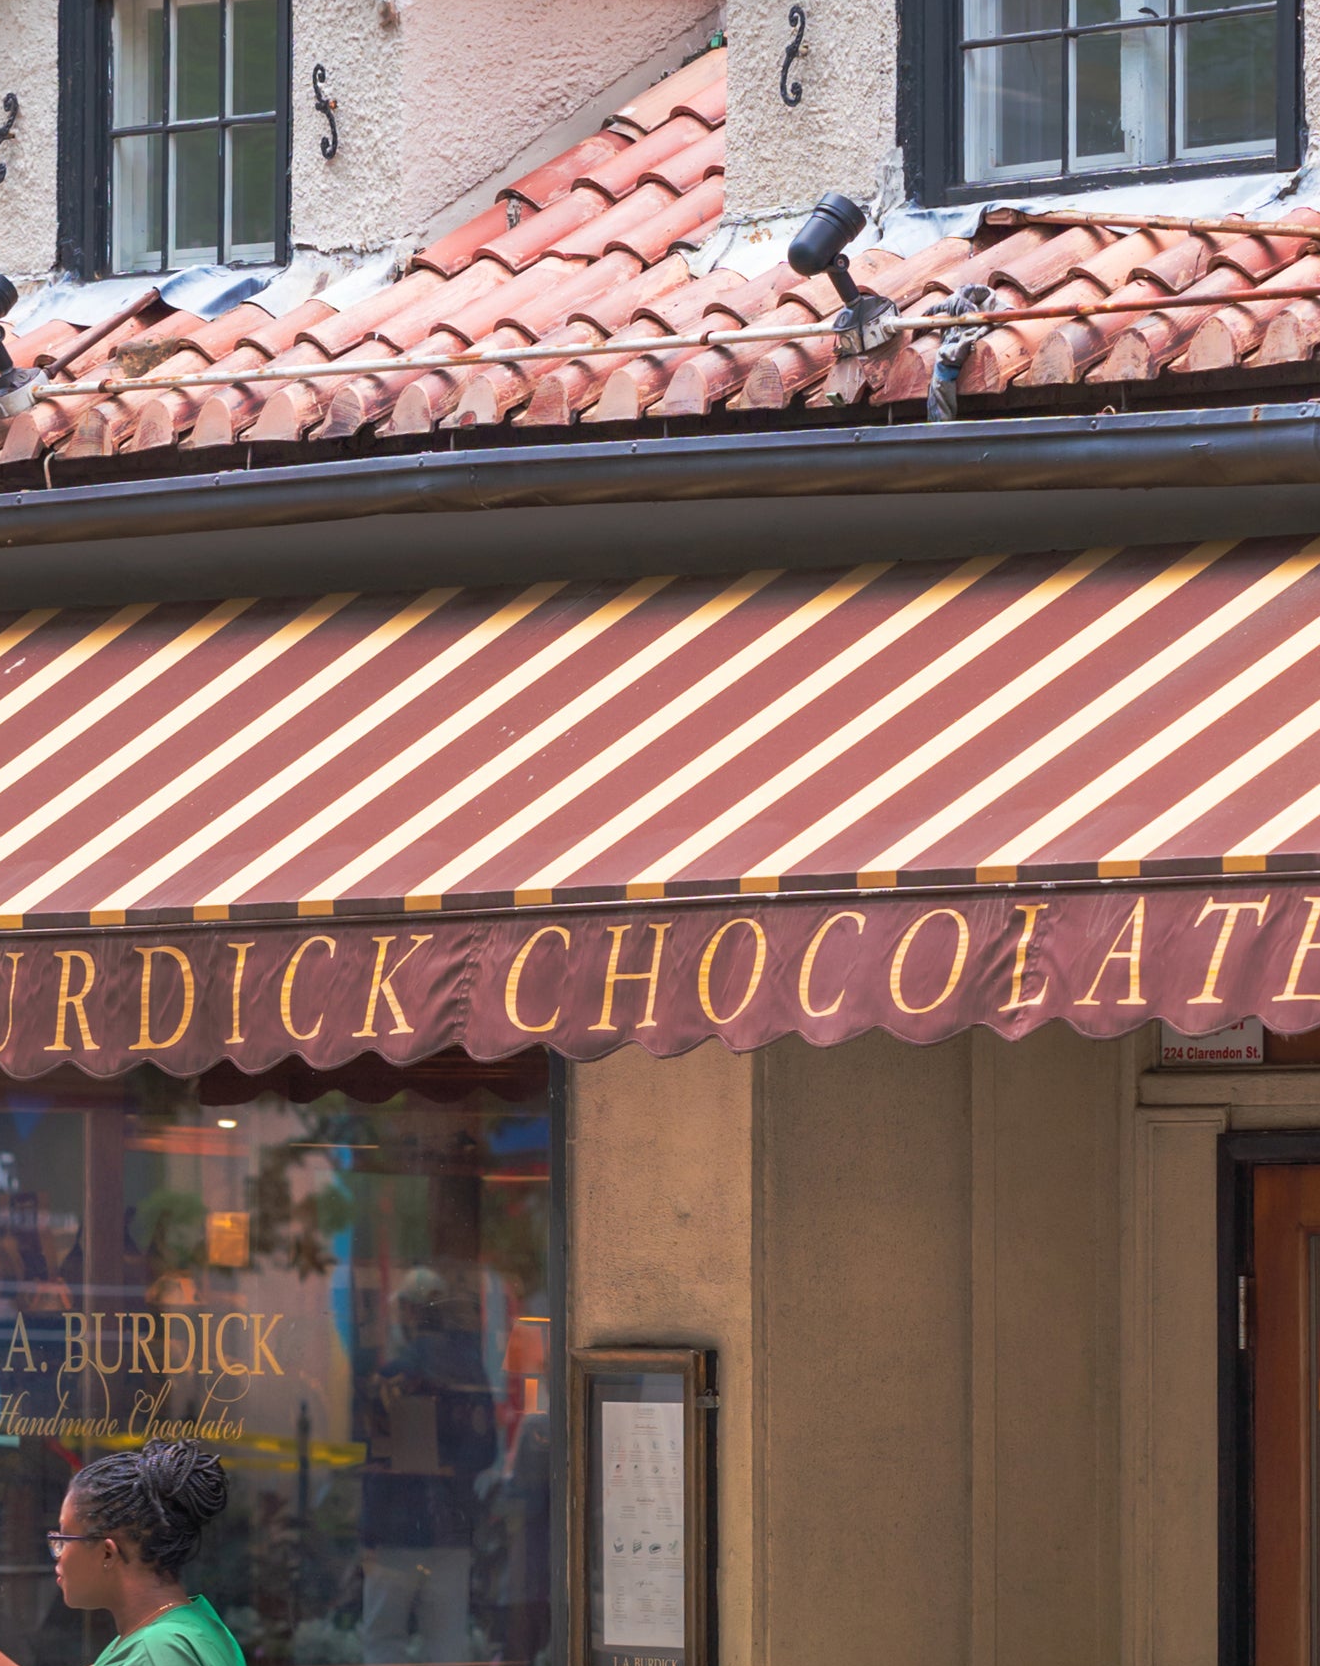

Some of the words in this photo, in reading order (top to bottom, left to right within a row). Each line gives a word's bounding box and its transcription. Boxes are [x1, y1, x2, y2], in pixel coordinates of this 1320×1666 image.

[1164, 1047, 1183, 1060] 224
[1187, 1045, 1242, 1060] Clarendon
[1246, 1046, 1261, 1059] St.
[61, 1312, 285, 1376] BURDICK
[128, 1371, 250, 1440] Chocolates
